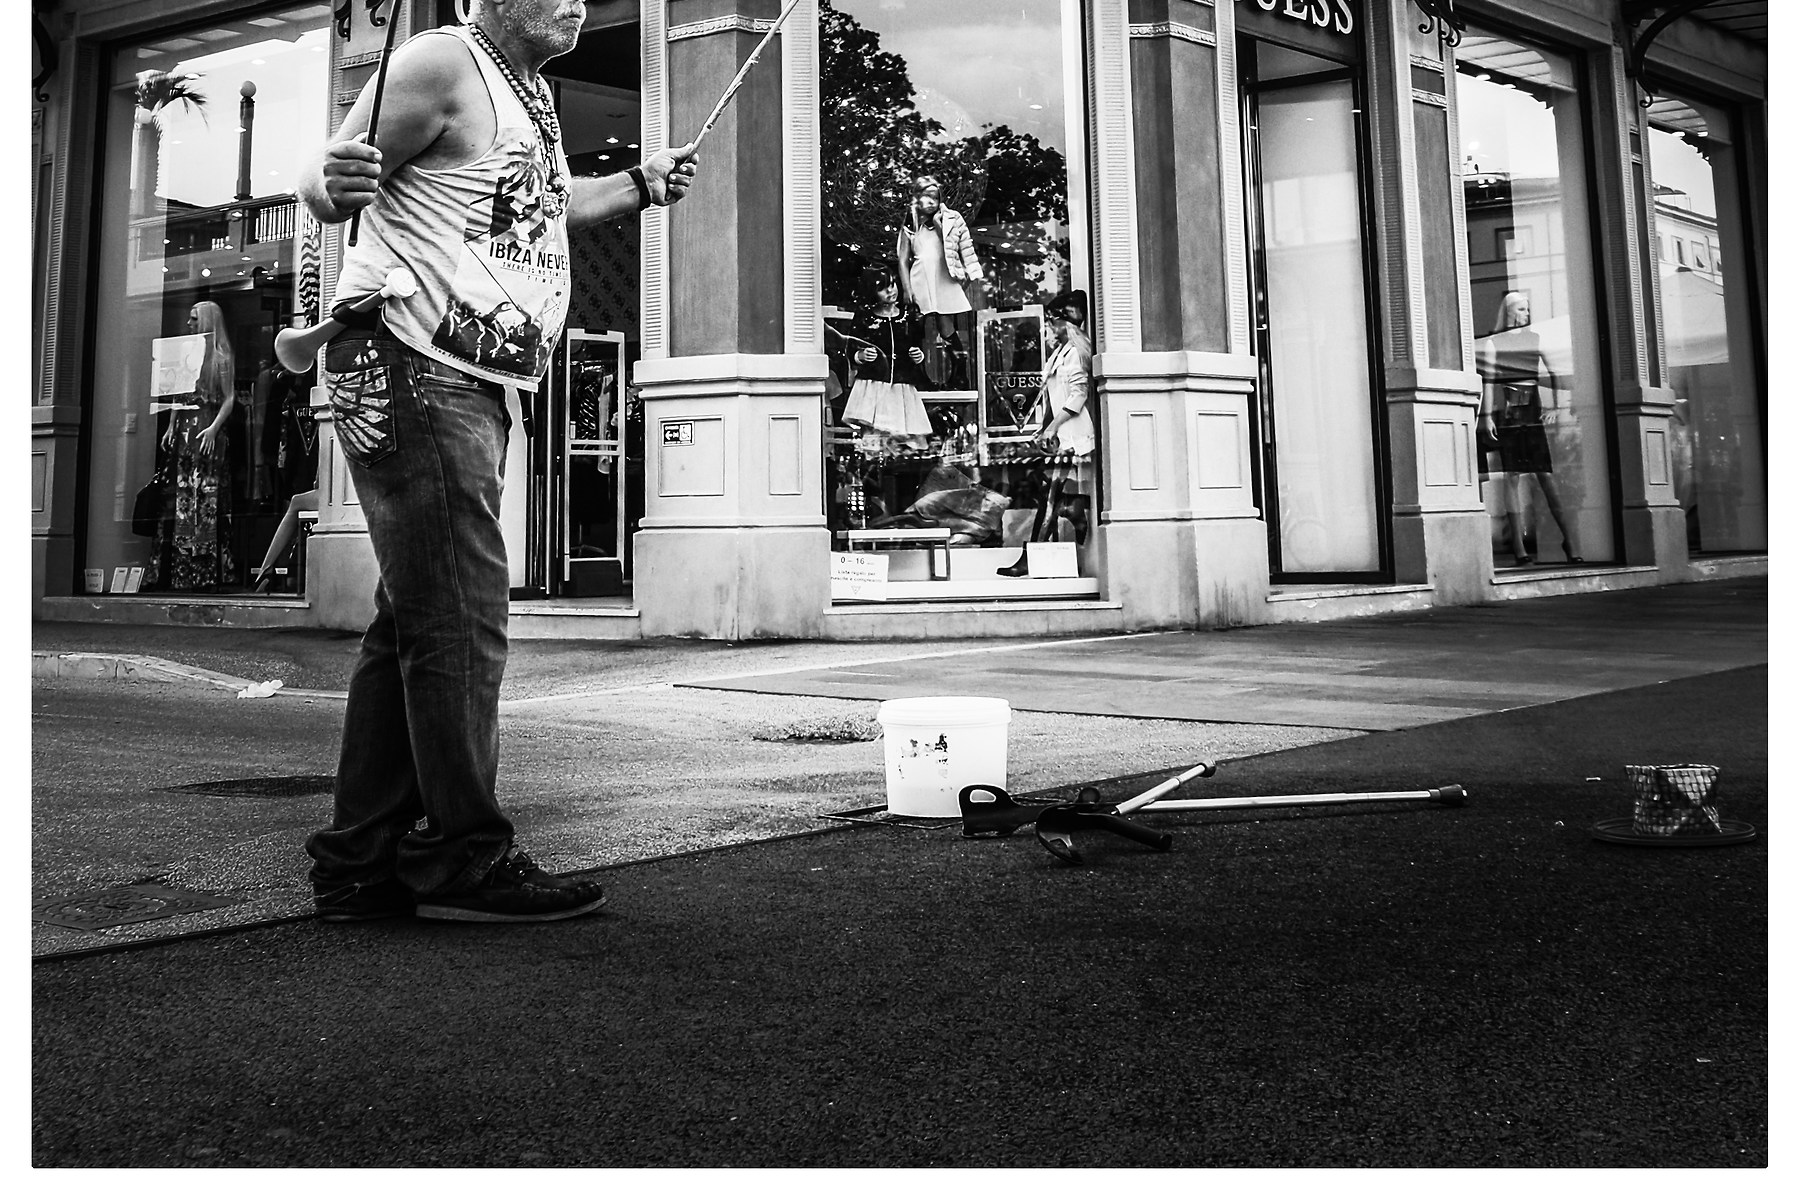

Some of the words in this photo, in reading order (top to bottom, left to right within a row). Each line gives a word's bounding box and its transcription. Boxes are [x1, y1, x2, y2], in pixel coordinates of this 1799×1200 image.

[489, 241, 531, 265] IBIZA
[996, 376, 1043, 388] GUESS
[296, 407, 314, 417] GUE
[840, 556, 846, 564] 0
[856, 557, 865, 565] 16
